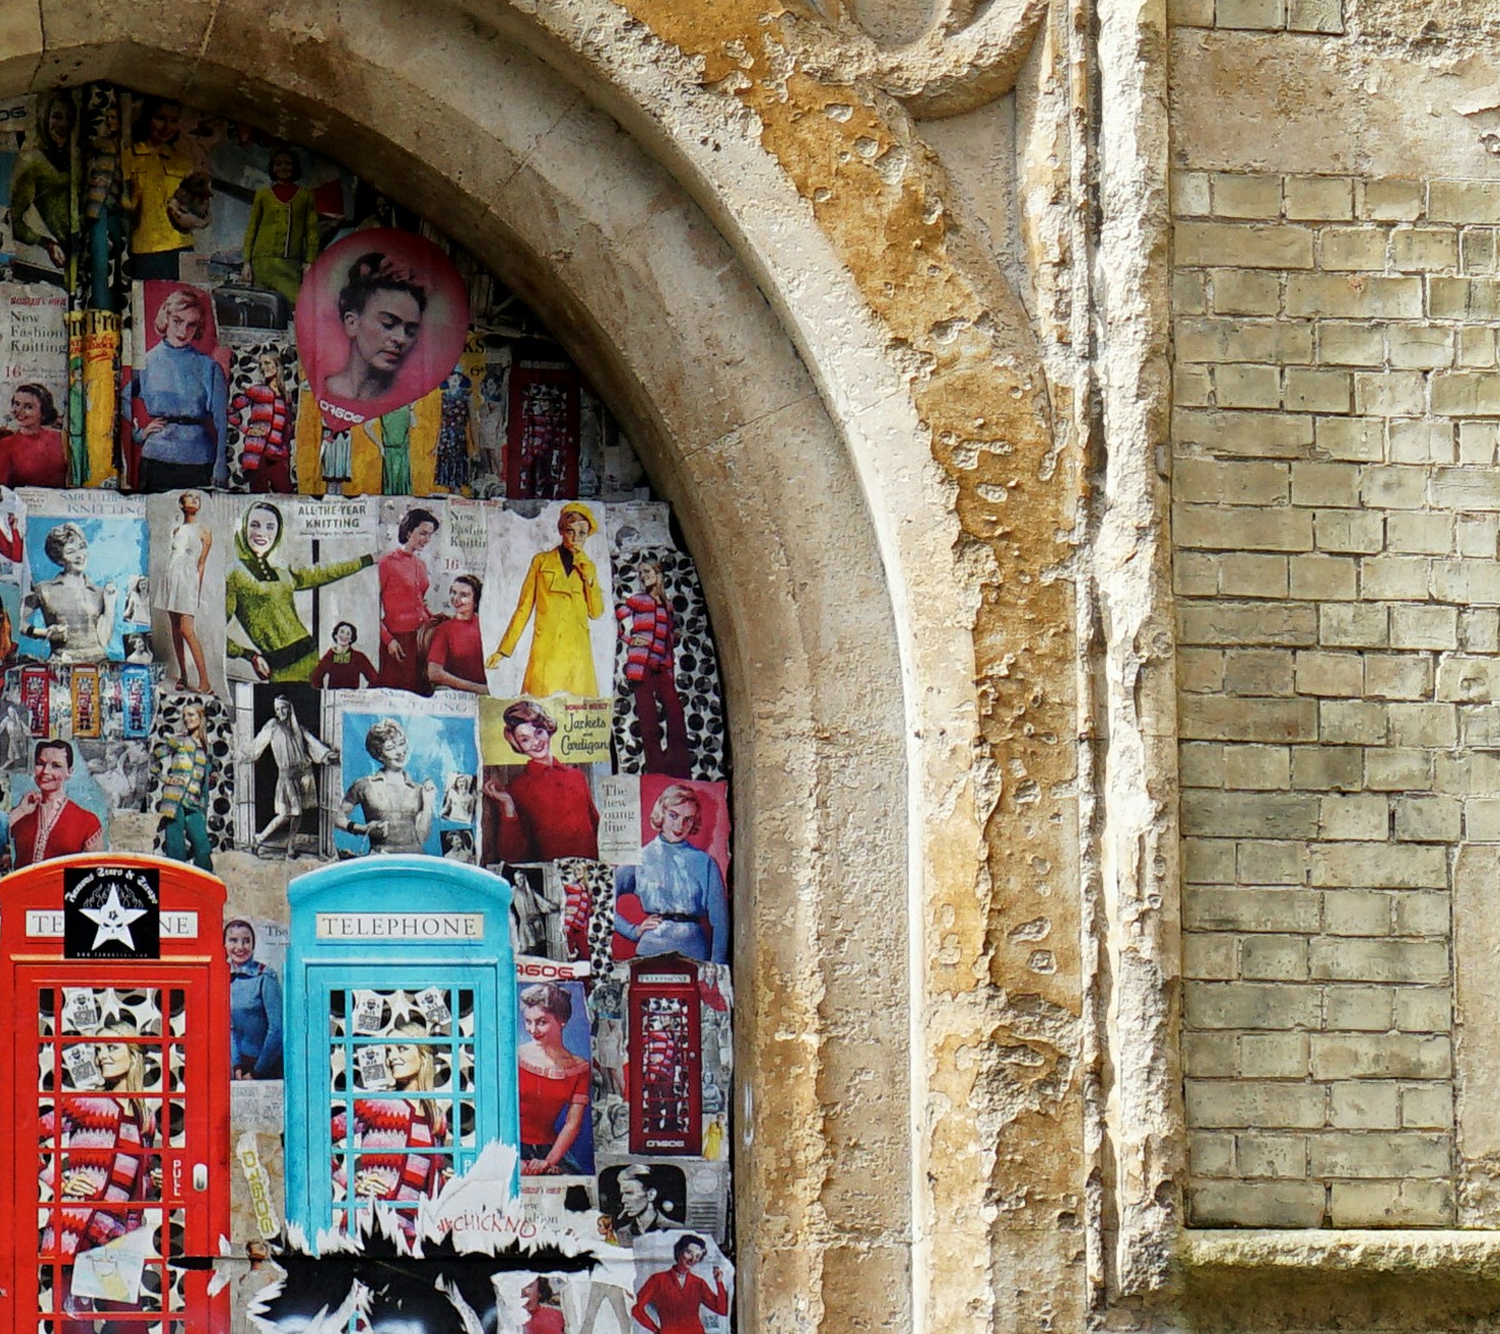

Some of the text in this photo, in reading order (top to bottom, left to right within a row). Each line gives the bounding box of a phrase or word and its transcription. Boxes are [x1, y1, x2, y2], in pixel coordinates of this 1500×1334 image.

[10, 311, 39, 325] New
[4, 365, 22, 378] 16
[305, 517, 361, 529] KNITTING
[444, 558, 460, 571] 16
[563, 713, 607, 732] Jackets
[602, 783, 628, 798] The
[321, 917, 477, 937] TELEPHONE
[172, 1159, 182, 1197] PULL
